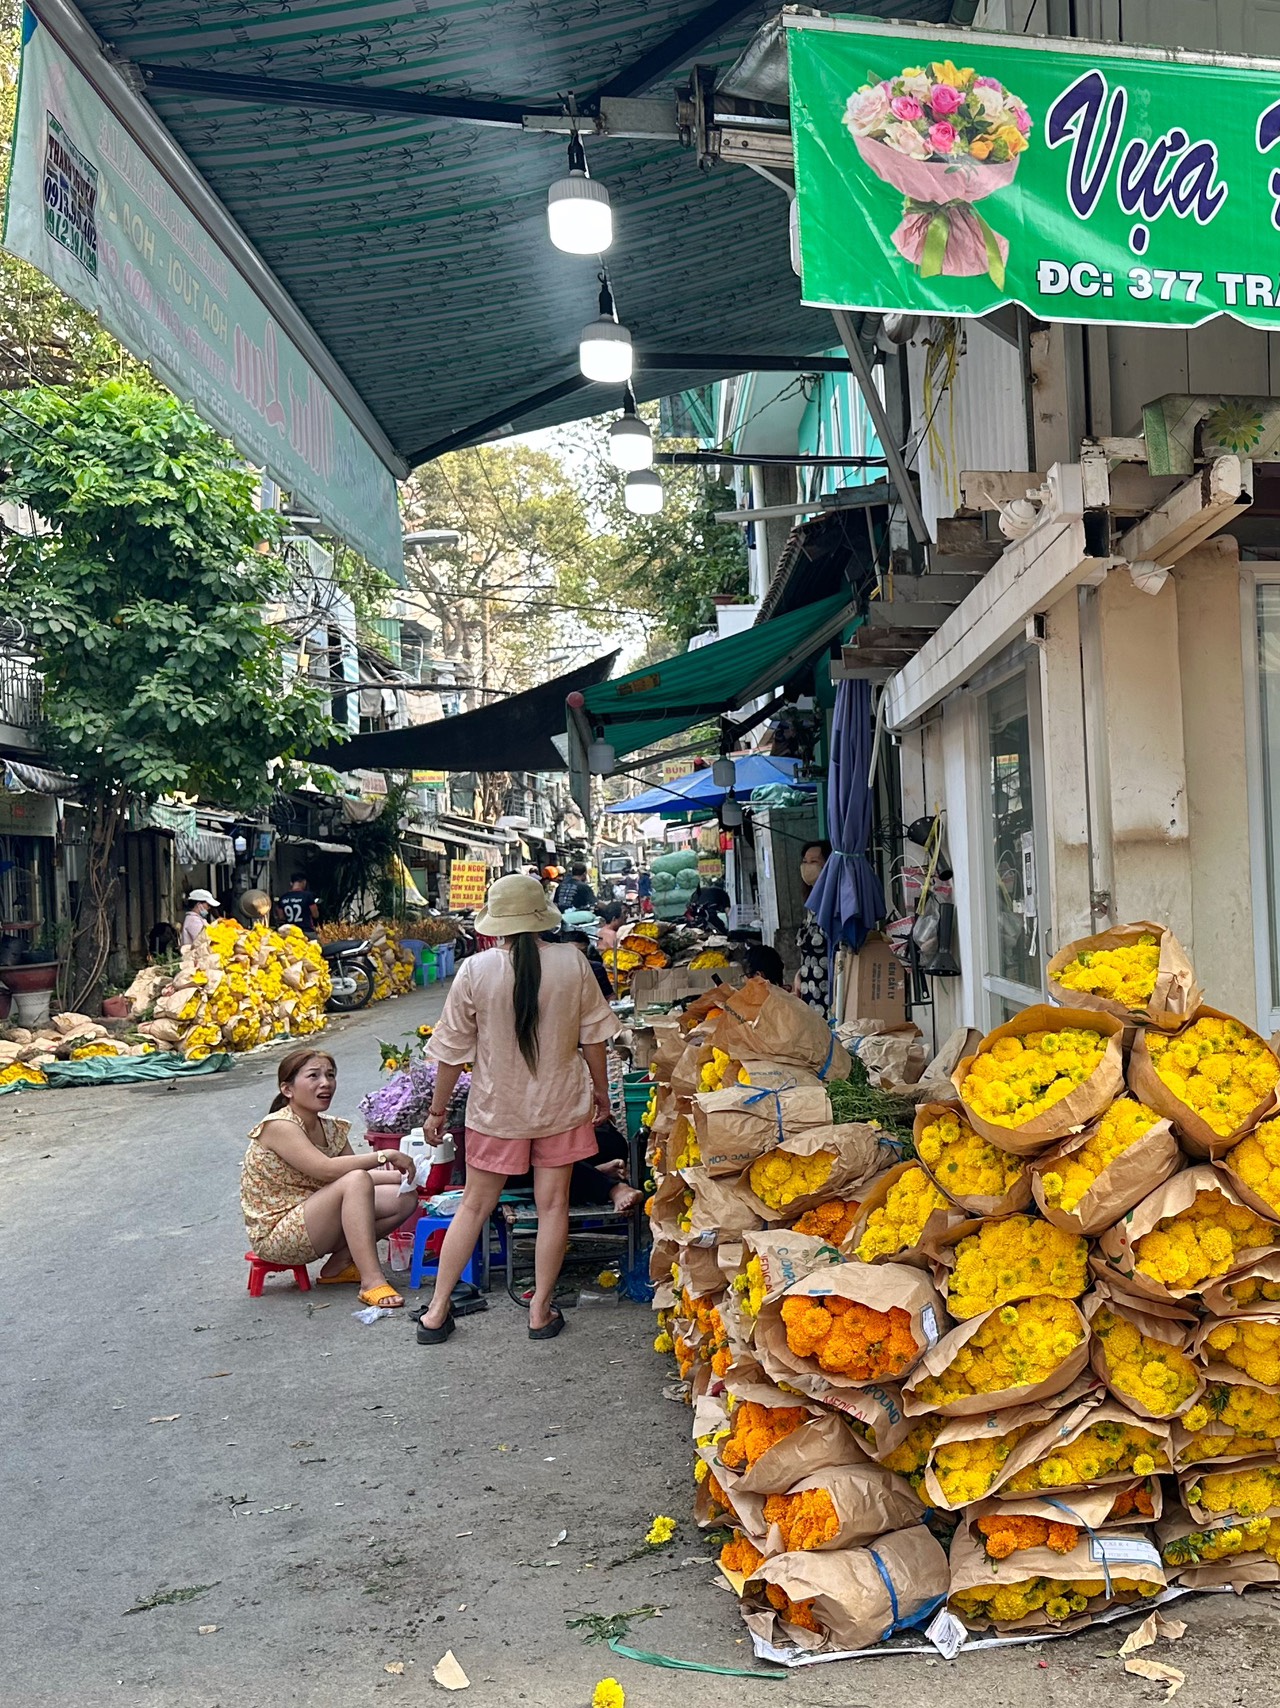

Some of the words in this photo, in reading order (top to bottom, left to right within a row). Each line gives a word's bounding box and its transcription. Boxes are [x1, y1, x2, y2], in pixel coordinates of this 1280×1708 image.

[1045, 68, 1228, 255] Vựa
[1037, 260, 1113, 298] ĐC:
[1128, 266, 1201, 302] 377
[284, 904, 303, 922] 92
